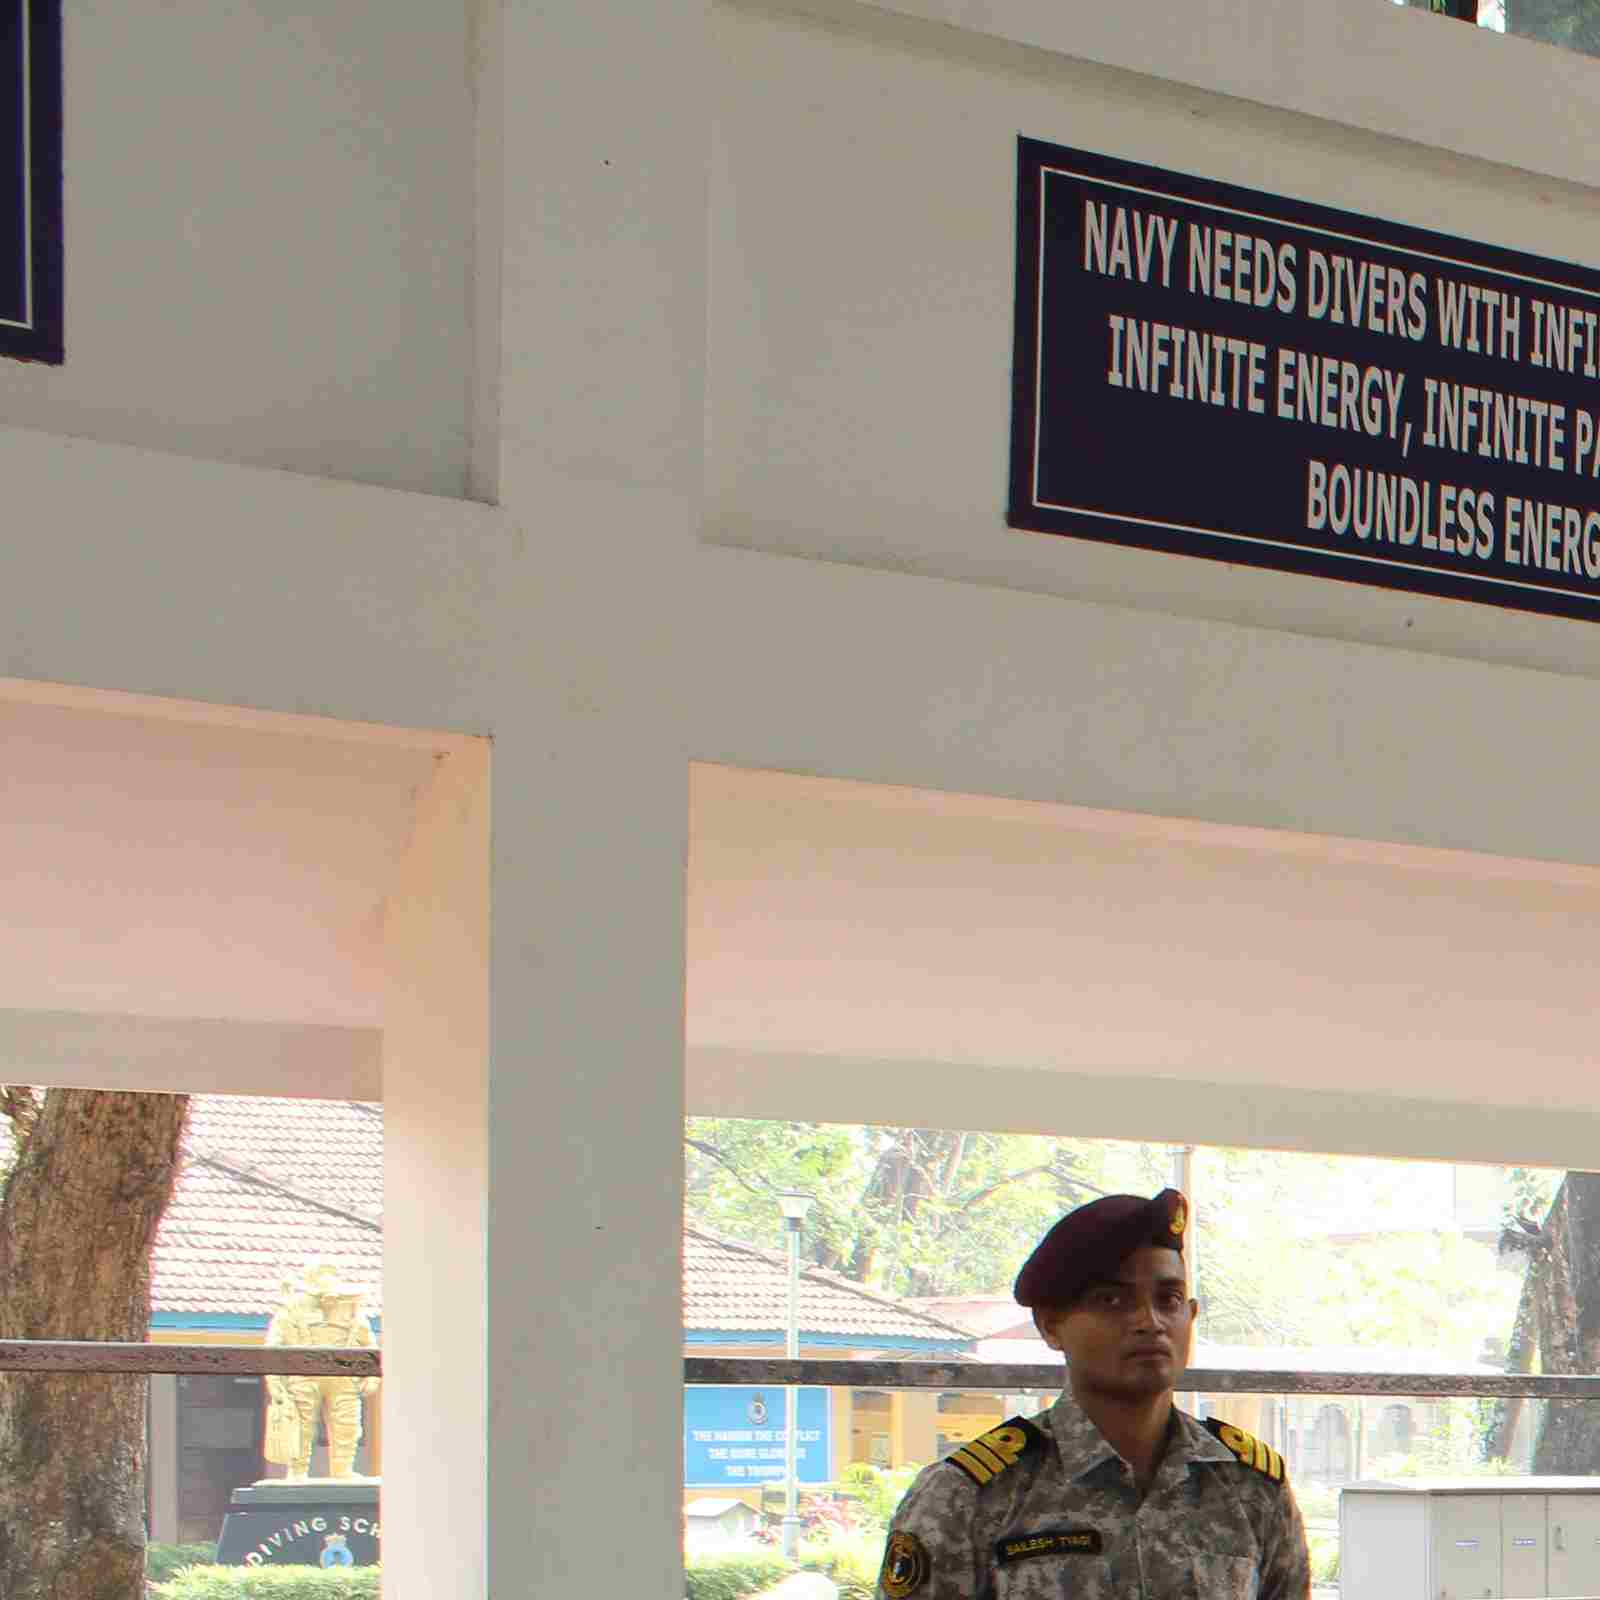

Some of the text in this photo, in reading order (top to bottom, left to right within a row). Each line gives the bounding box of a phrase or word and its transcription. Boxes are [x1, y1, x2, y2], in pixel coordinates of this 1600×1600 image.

[1084, 199, 1178, 289] NAVY
[1189, 223, 1297, 314] NEEDS
[1307, 249, 1427, 341] DIVERS
[1437, 278, 1521, 361] WITH
[1108, 314, 1266, 414] INFINITE
[1277, 348, 1412, 457] ENERGY,
[1423, 378, 1565, 471] INFINITE
[1307, 459, 1495, 560] BOUNDLESS
[244, 1516, 328, 1568] DIVING
